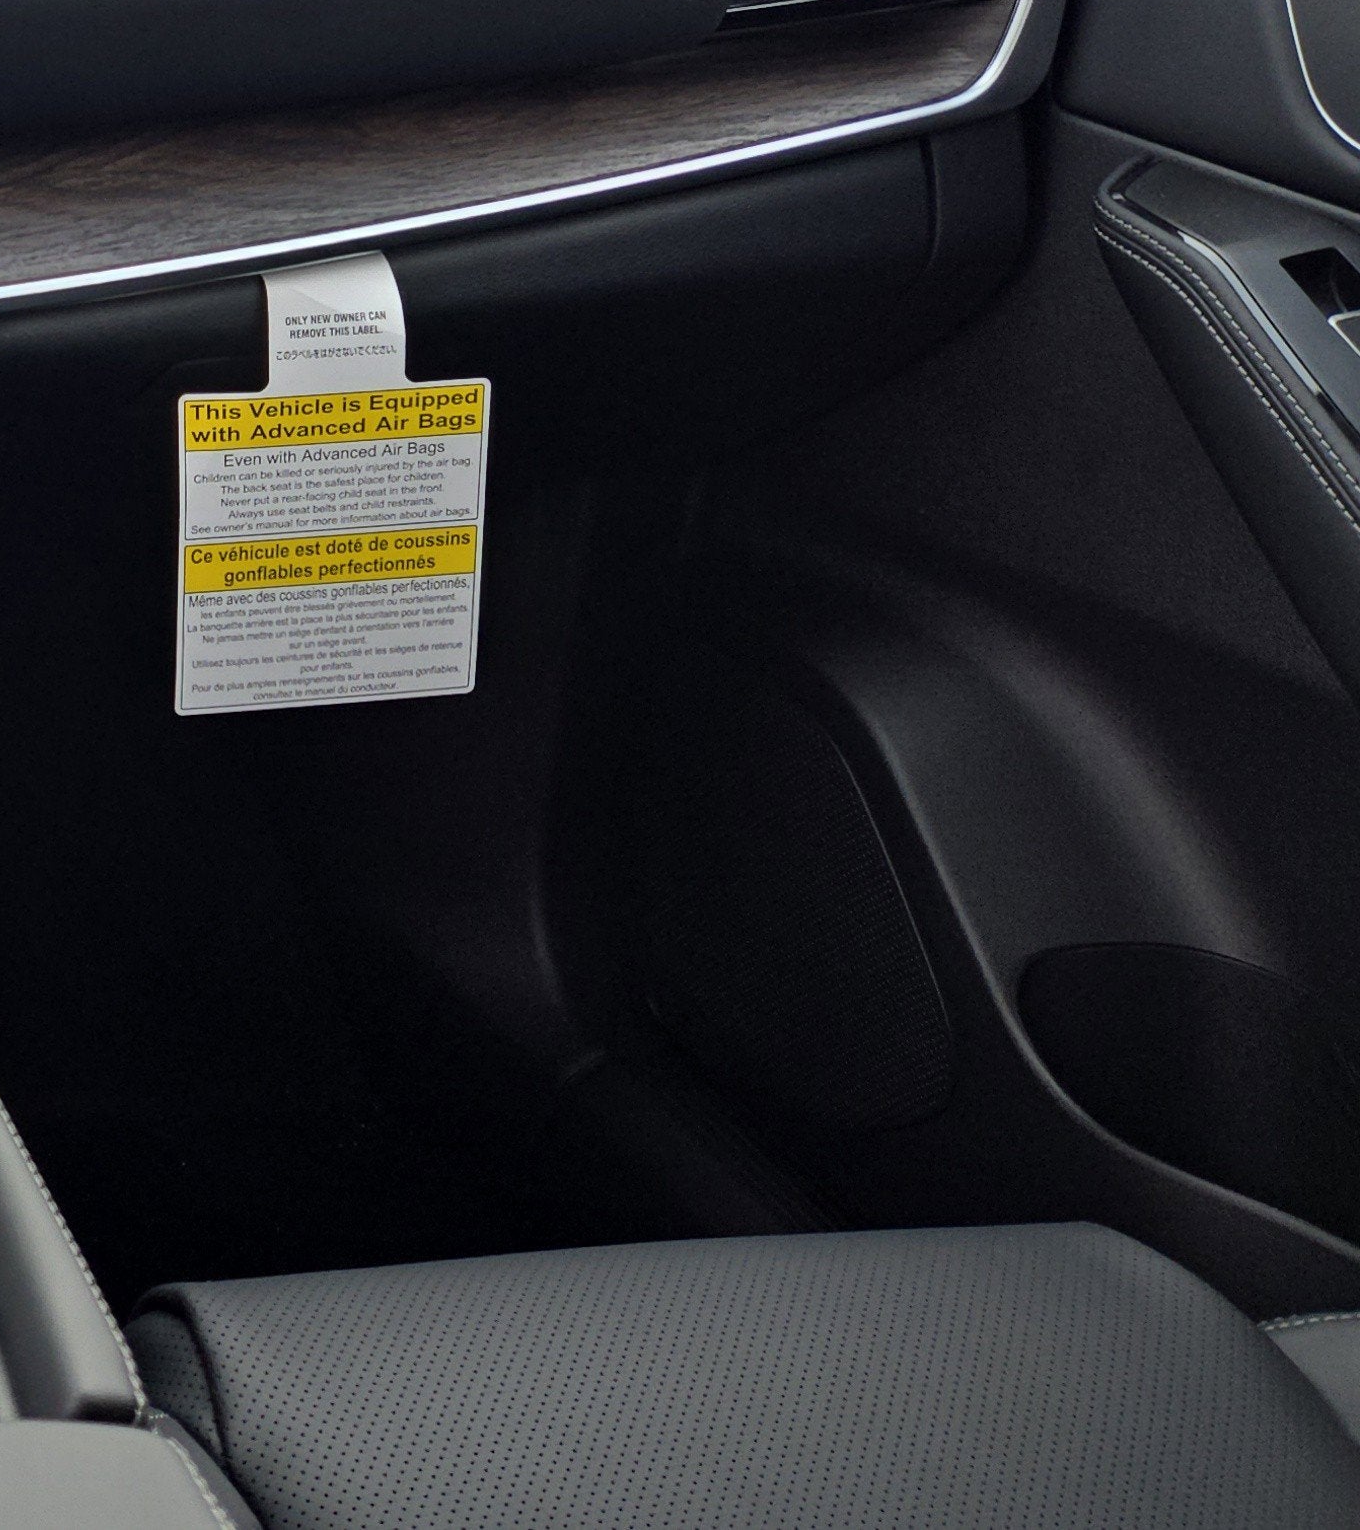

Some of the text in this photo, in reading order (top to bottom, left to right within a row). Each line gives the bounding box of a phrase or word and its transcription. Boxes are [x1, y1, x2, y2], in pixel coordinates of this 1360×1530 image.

[285, 310, 387, 326] ONLY NEW OWNER CAN
[289, 325, 383, 339] REMOVE THIS LABEL.
[190, 388, 479, 420] This Vehicle is Equipped
[191, 413, 477, 442] with Advanced Air Bags
[224, 442, 445, 468] Even with Advanced Air Bags
[193, 473, 236, 484] Children
[239, 473, 258, 481] can
[260, 470, 273, 480] be
[276, 468, 302, 478] killed
[305, 469, 316, 477] or
[318, 462, 362, 475] seriously
[365, 461, 400, 474] injured
[402, 460, 414, 470] by
[417, 458, 433, 468] the
[436, 458, 449, 467] air
[221, 485, 240, 495] The
[243, 483, 267, 494] back
[270, 481, 292, 492] seat
[294, 480, 303, 489] is
[305, 479, 321, 489] the
[324, 477, 355, 488] safest
[357, 475, 386, 487] place
[387, 473, 401, 483] for
[221, 497, 251, 508] Never
[253, 496, 270, 507] put
[281, 491, 337, 504] rear-facing
[338, 489, 363, 500] child
[365, 487, 388, 498] seat
[389, 486, 399, 495] in
[401, 485, 418, 495] the
[191, 524, 211, 535] See
[214, 522, 254, 533] owner's
[256, 519, 294, 530] manual
[296, 517, 310, 527] for
[312, 517, 338, 526] more
[340, 511, 397, 525] information
[399, 509, 428, 520] about
[430, 508, 443, 518] air
[228, 510, 265, 521] Always
[267, 509, 286, 517] use
[288, 506, 310, 516] seat
[313, 504, 337, 514] belts
[340, 501, 359, 512] and
[361, 499, 385, 511] child
[191, 531, 471, 565] Ce véhicule est doté de coussins
[224, 555, 436, 587] gonflables perfectionnés
[188, 593, 224, 608] Même
[226, 593, 254, 605] avec
[256, 590, 277, 603] des
[279, 587, 328, 602] coussins
[330, 581, 389, 601] gonflables
